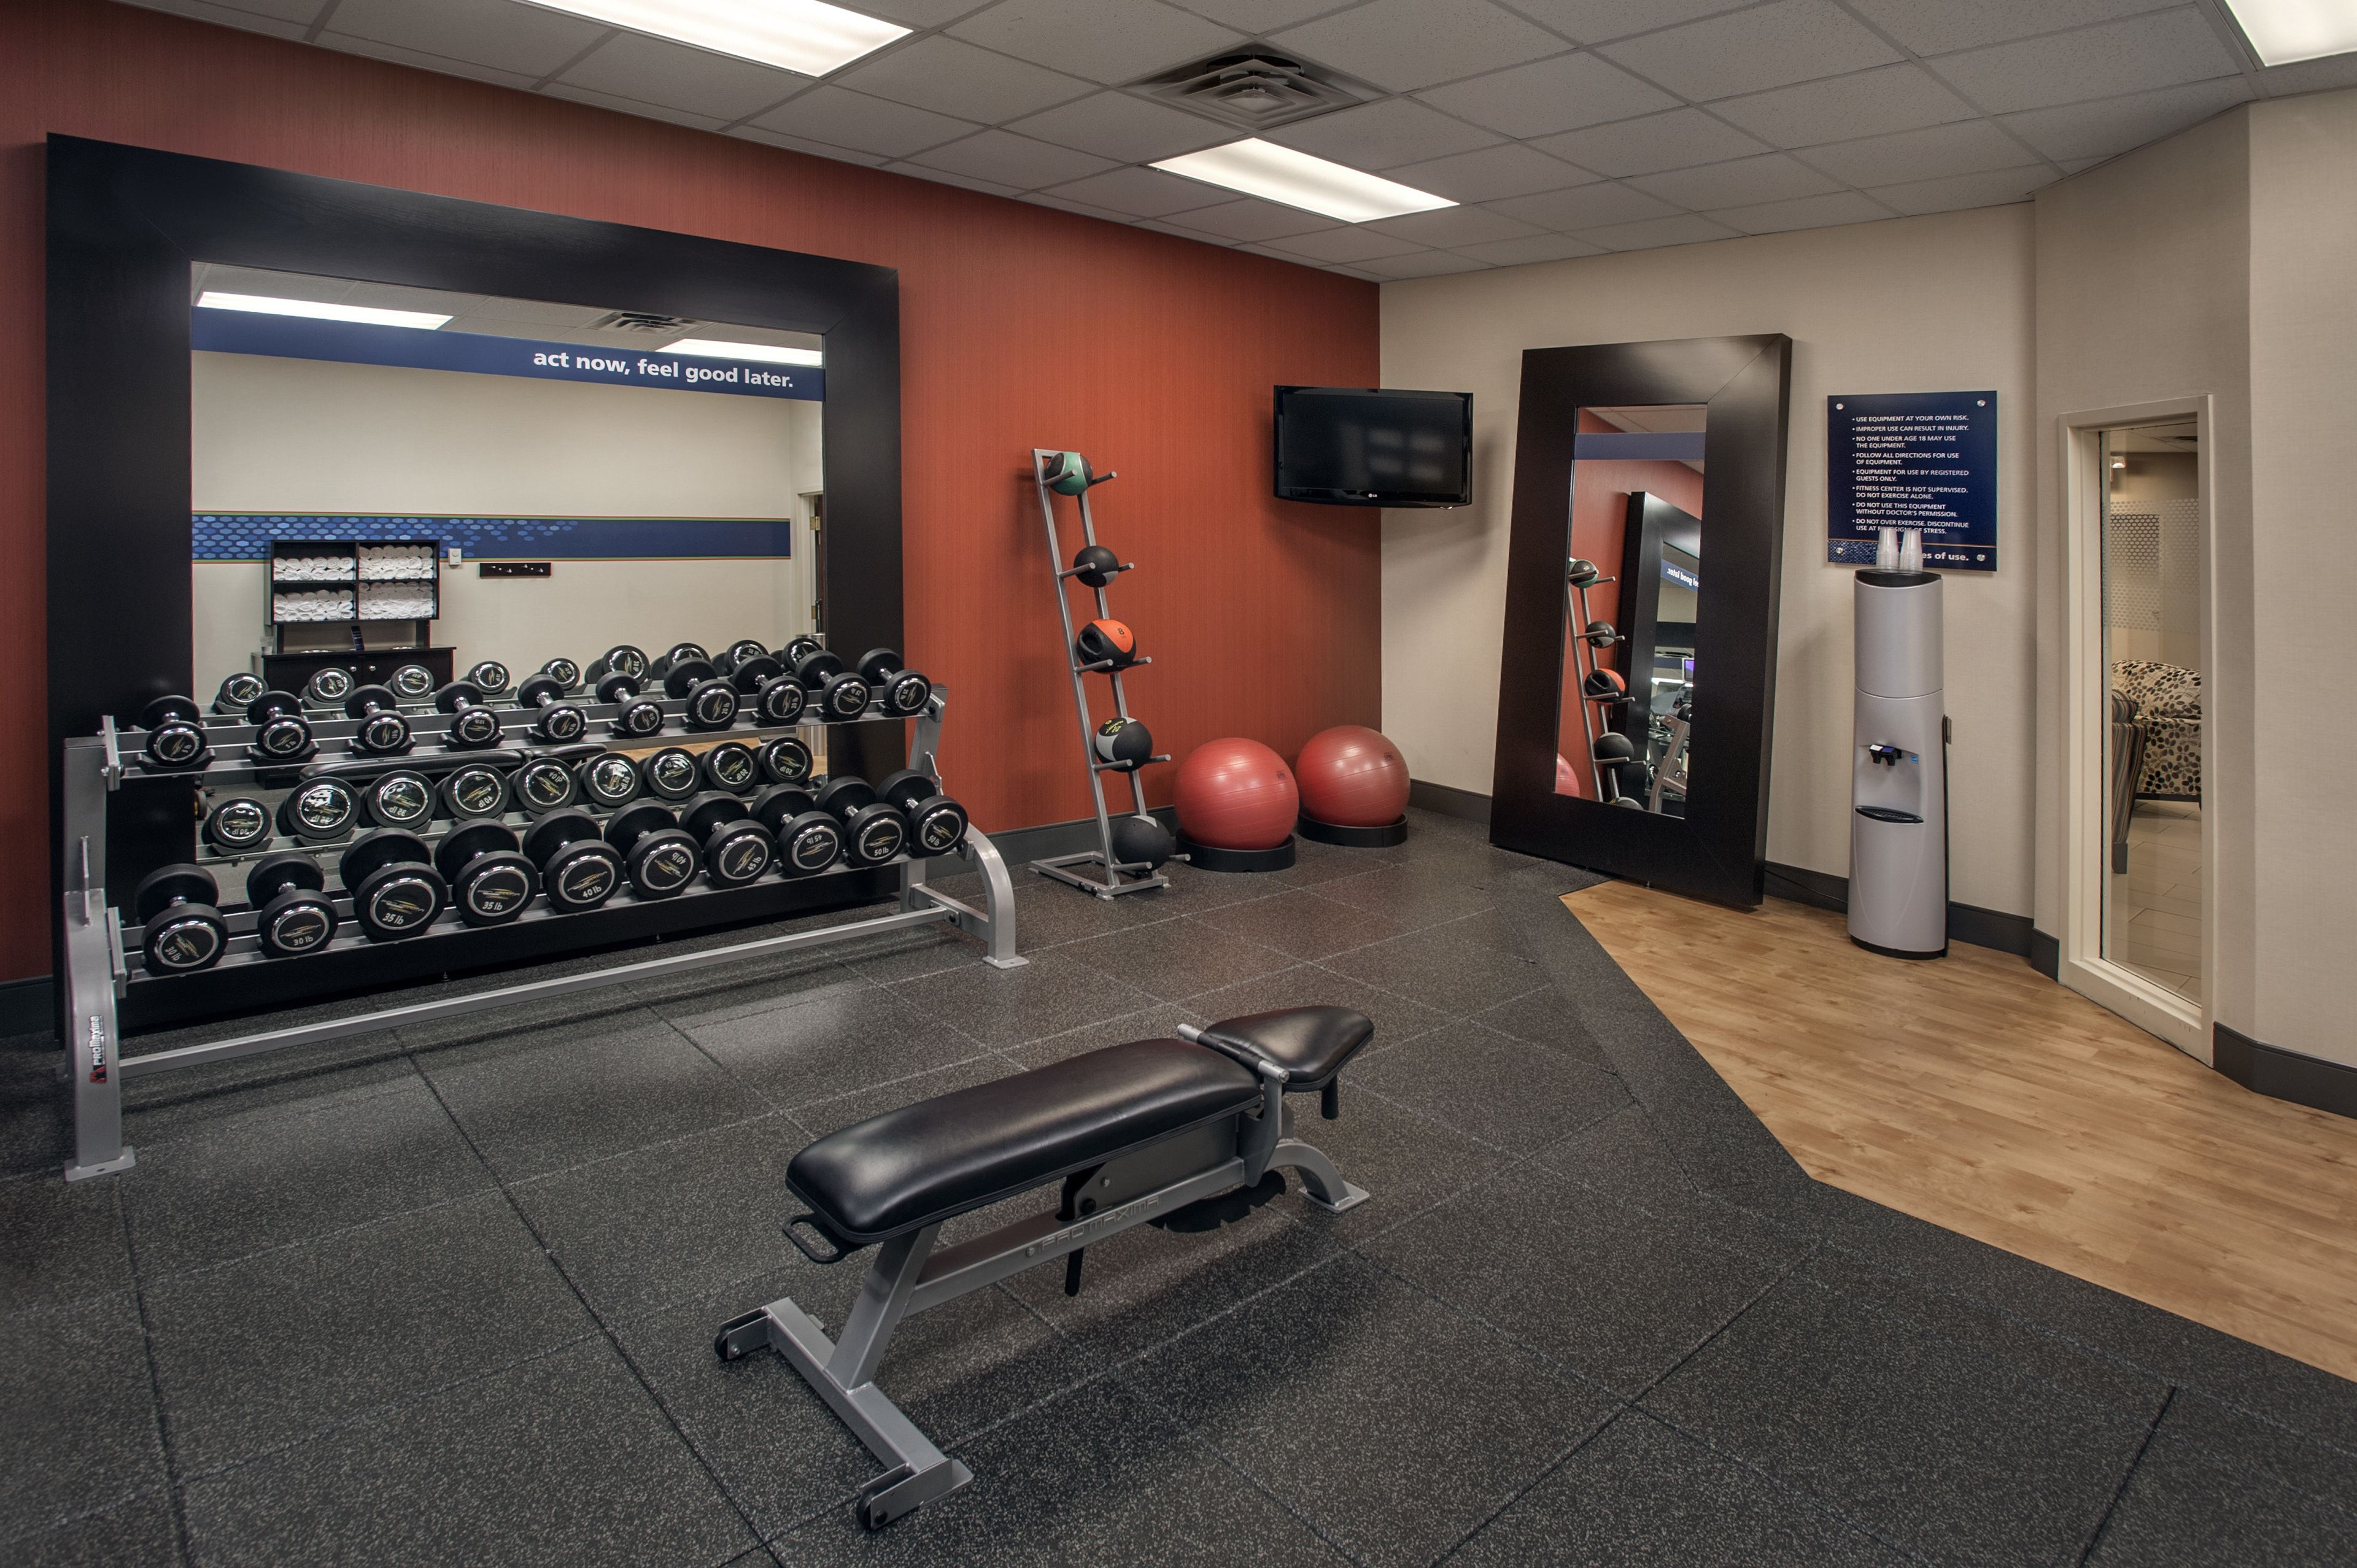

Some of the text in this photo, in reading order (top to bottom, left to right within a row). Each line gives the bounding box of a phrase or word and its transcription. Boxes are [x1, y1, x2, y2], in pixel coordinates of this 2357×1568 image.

[534, 352, 793, 388] act now, feel good later.
[583, 890, 593, 898] 40
[482, 902, 503, 911] 35 lb
[382, 913, 404, 924] 35 lb
[293, 938, 303, 946] 30
[166, 946, 178, 956] 30
[1042, 1196, 1159, 1251] PRO MAXIMA
